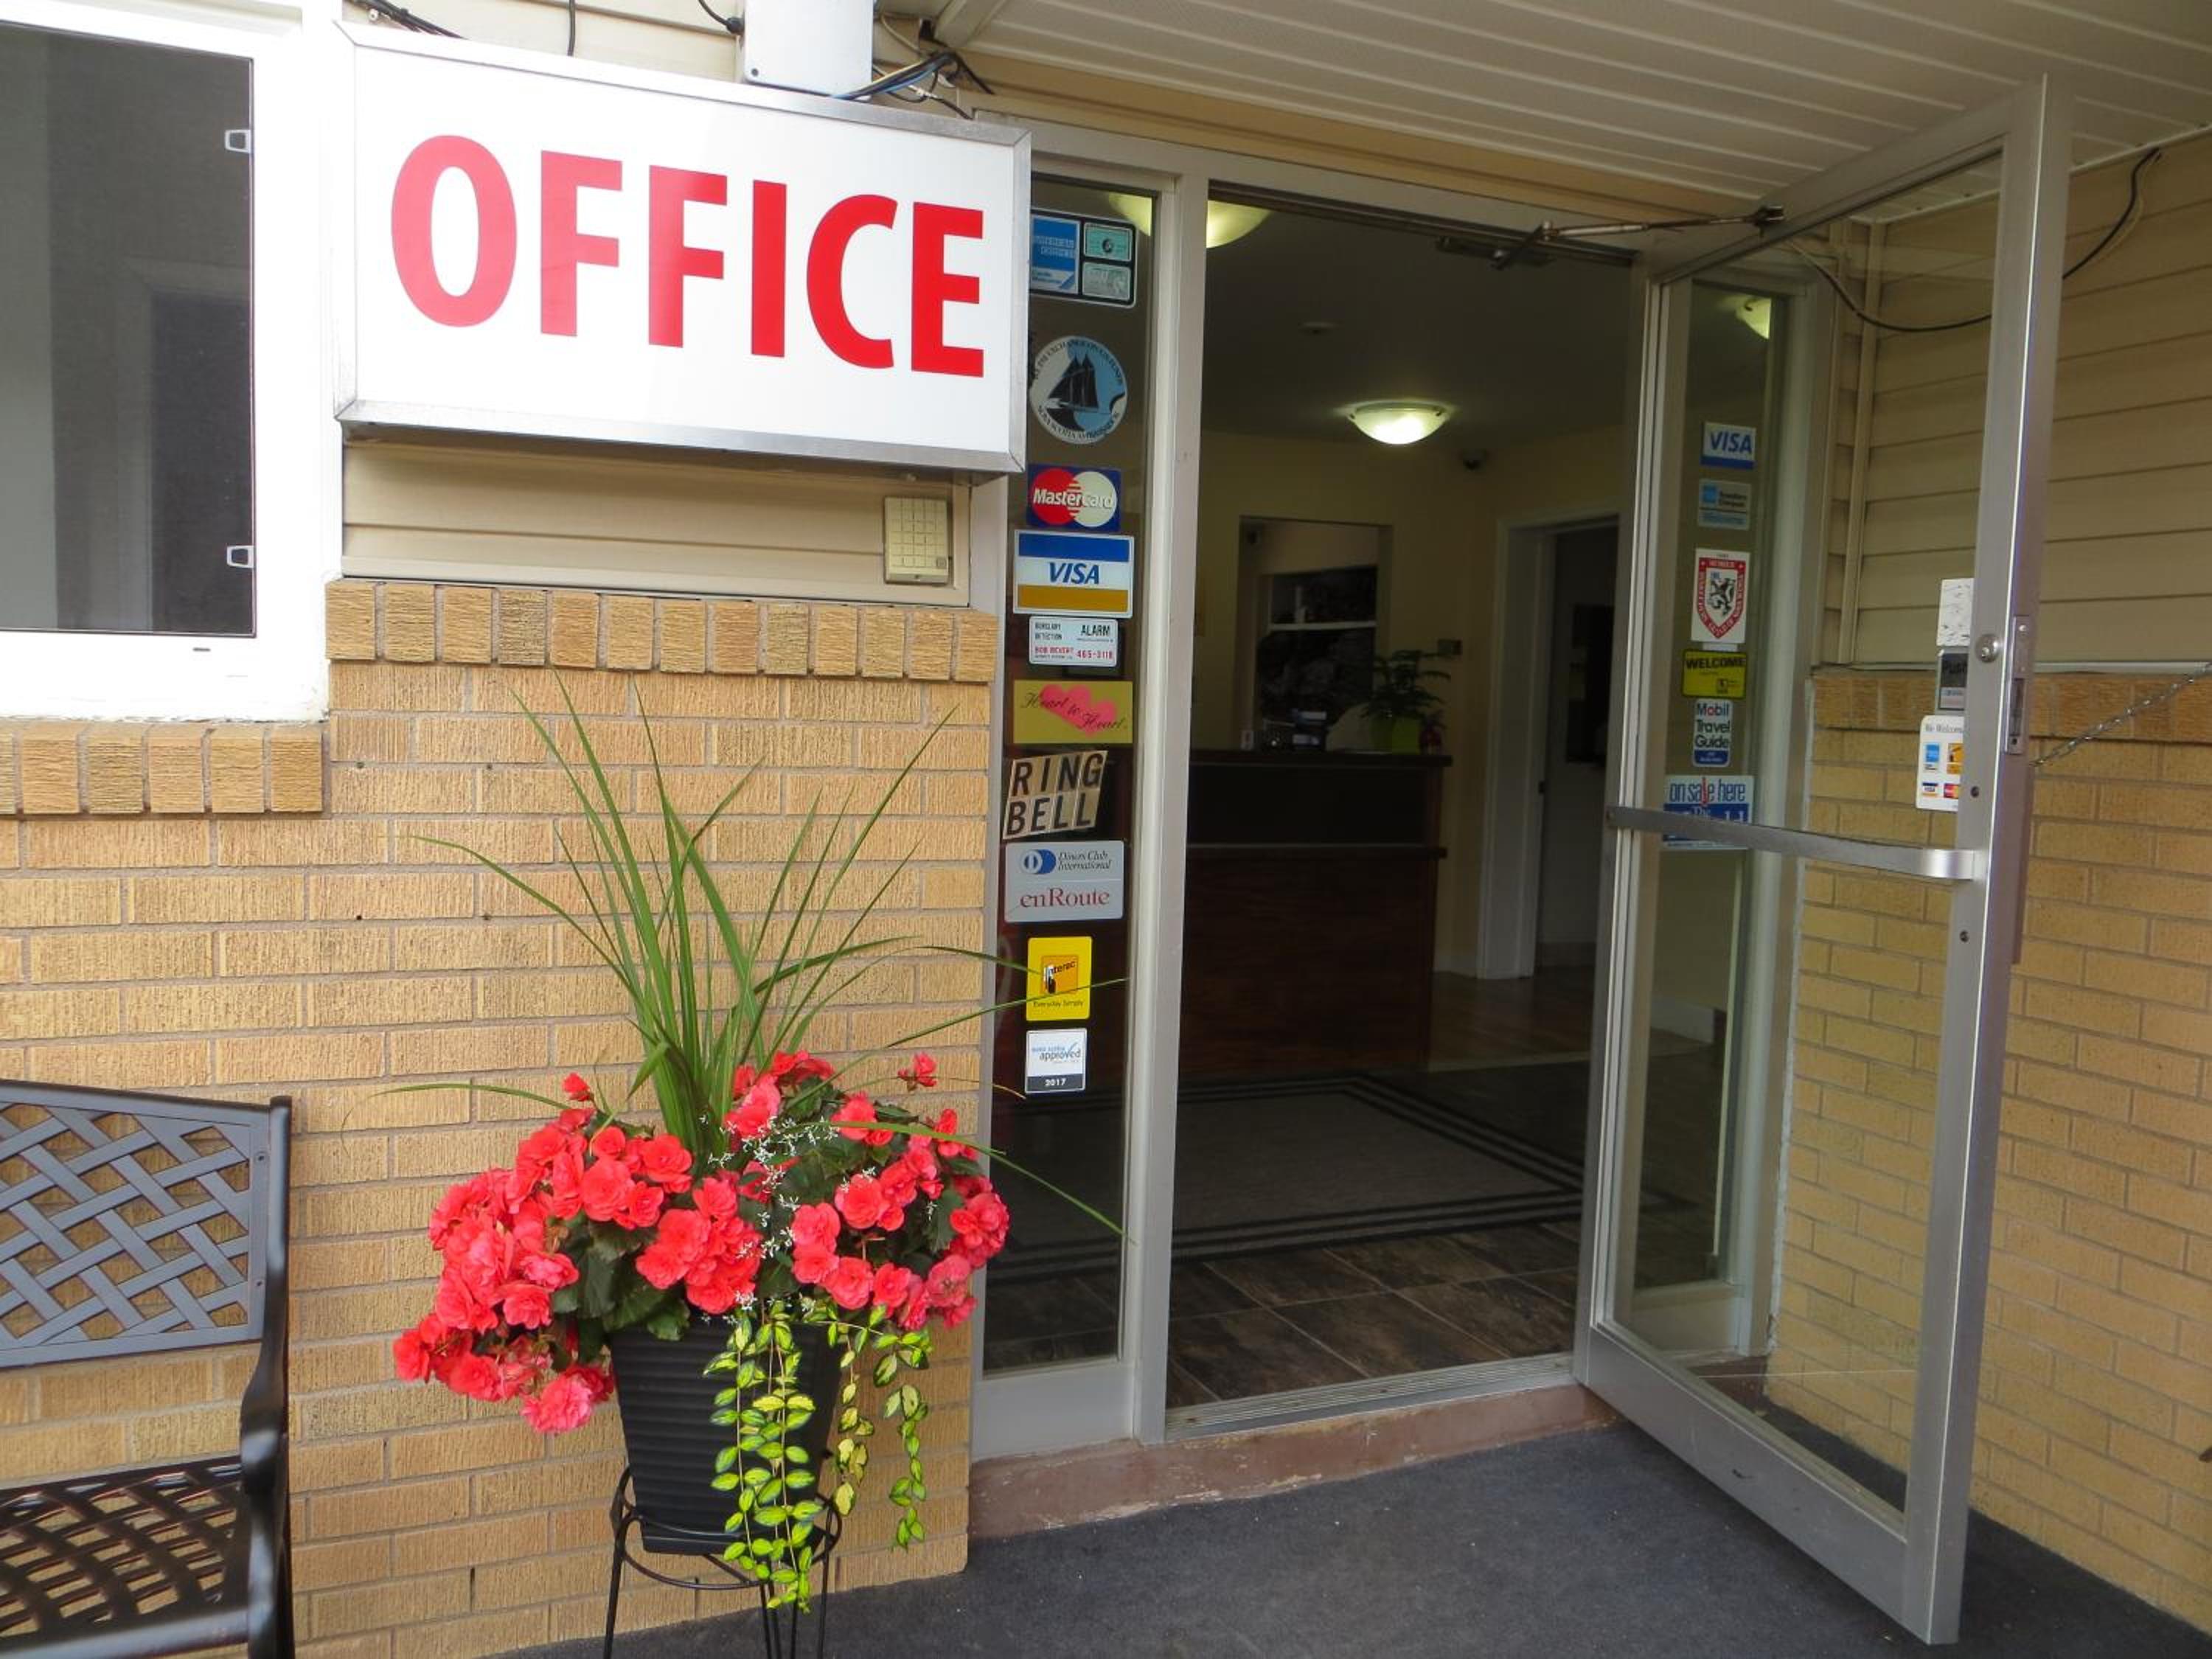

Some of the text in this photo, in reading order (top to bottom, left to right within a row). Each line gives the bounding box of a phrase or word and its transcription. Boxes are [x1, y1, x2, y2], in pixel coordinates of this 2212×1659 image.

[391, 134, 984, 378] OFFICE
[1710, 431, 1752, 454] VISA
[1033, 487, 1113, 509] MasterCard
[1049, 562, 1100, 585] VISA
[1080, 625, 1110, 636] ALARM
[1686, 655, 1746, 669] WELCOME
[1020, 692, 1069, 709] Heart
[1068, 703, 1081, 715] to
[1697, 703, 1730, 717] Mobil
[1697, 720, 1731, 734] Travel
[1695, 733, 1730, 749] Guide
[1012, 753, 1104, 796] RING
[1669, 783, 1686, 802] on
[1718, 778, 1746, 802] here
[1006, 793, 1091, 835] BELL
[1088, 849, 1108, 860] Club
[1058, 860, 1113, 871] International
[1020, 887, 1110, 908] enRoute
[1039, 1047, 1082, 1061] approved
[1045, 1078, 1067, 1086] 2017
